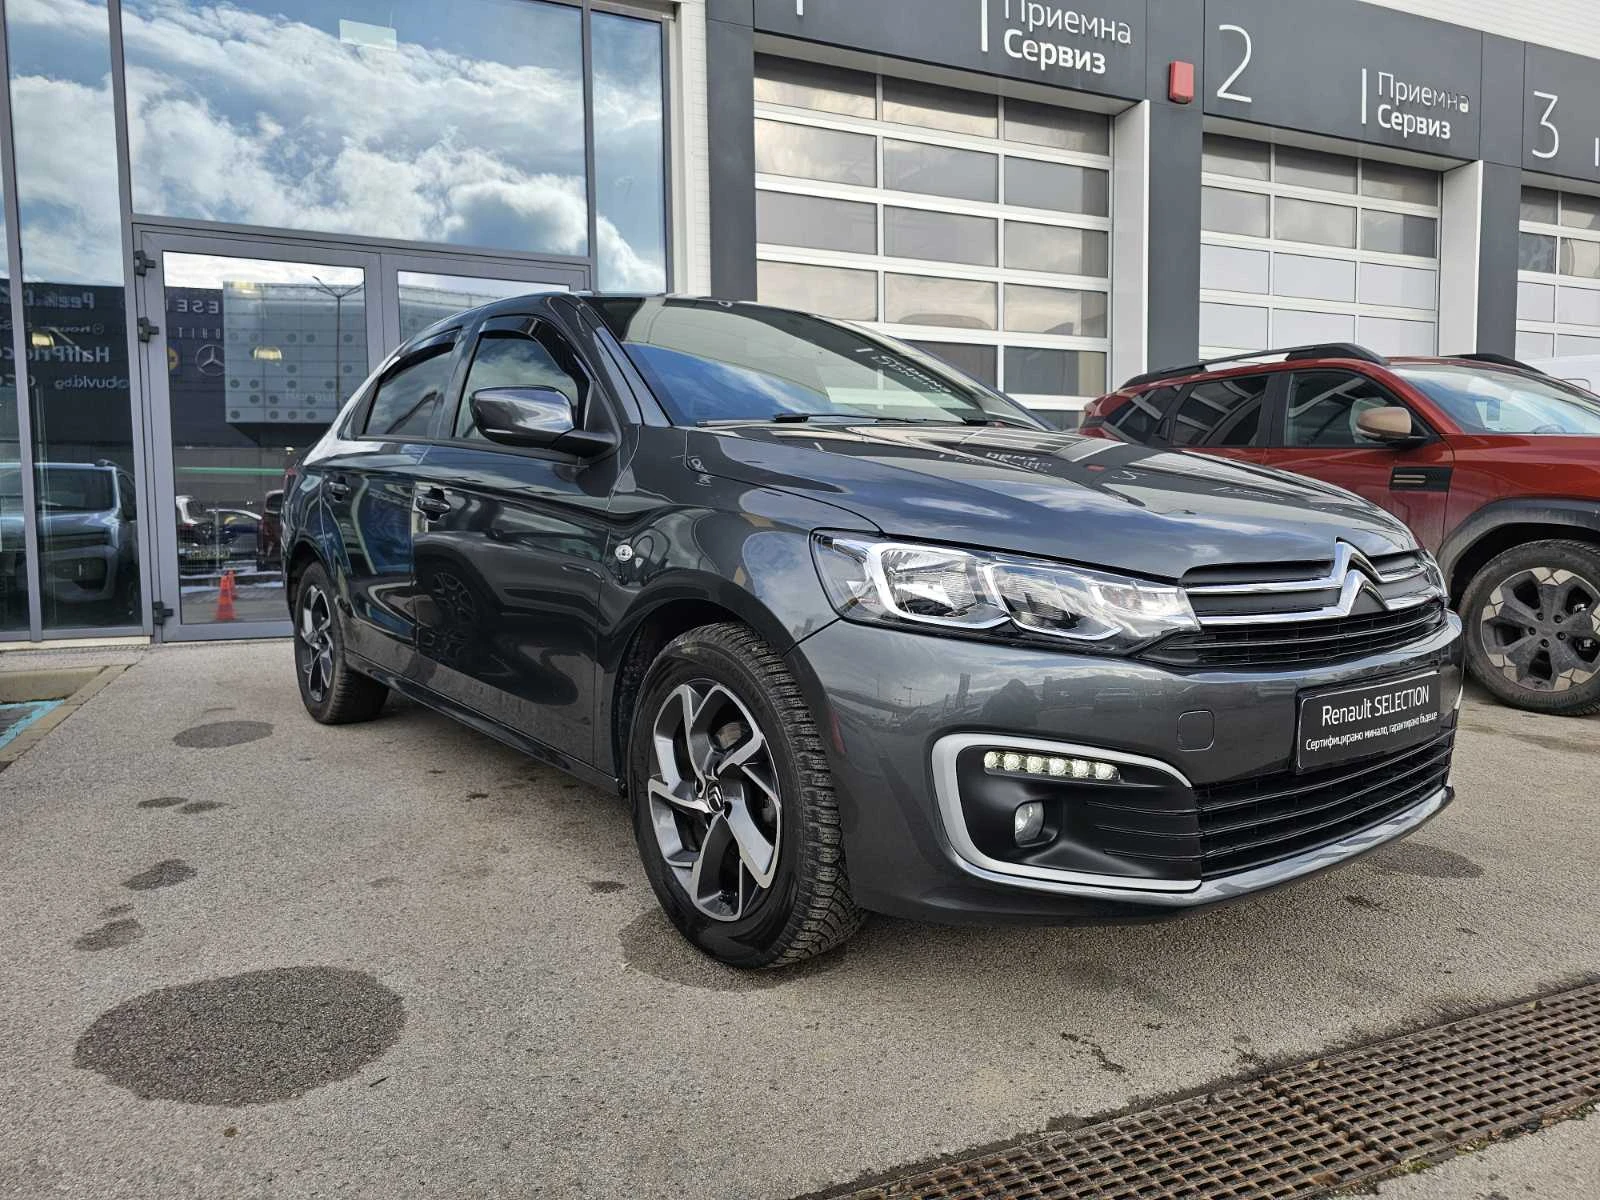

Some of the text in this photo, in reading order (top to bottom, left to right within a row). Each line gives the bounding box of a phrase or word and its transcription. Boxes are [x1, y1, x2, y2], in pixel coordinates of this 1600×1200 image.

[1005, 0, 1132, 45] Приемна
[1004, 28, 1106, 74] Сервиз
[1216, 24, 1252, 103] 2
[1377, 71, 1470, 113] Приемна
[1377, 104, 1451, 139] Сервиз
[1531, 90, 1560, 159] 3
[1322, 685, 1430, 727] Renault SELECTION
